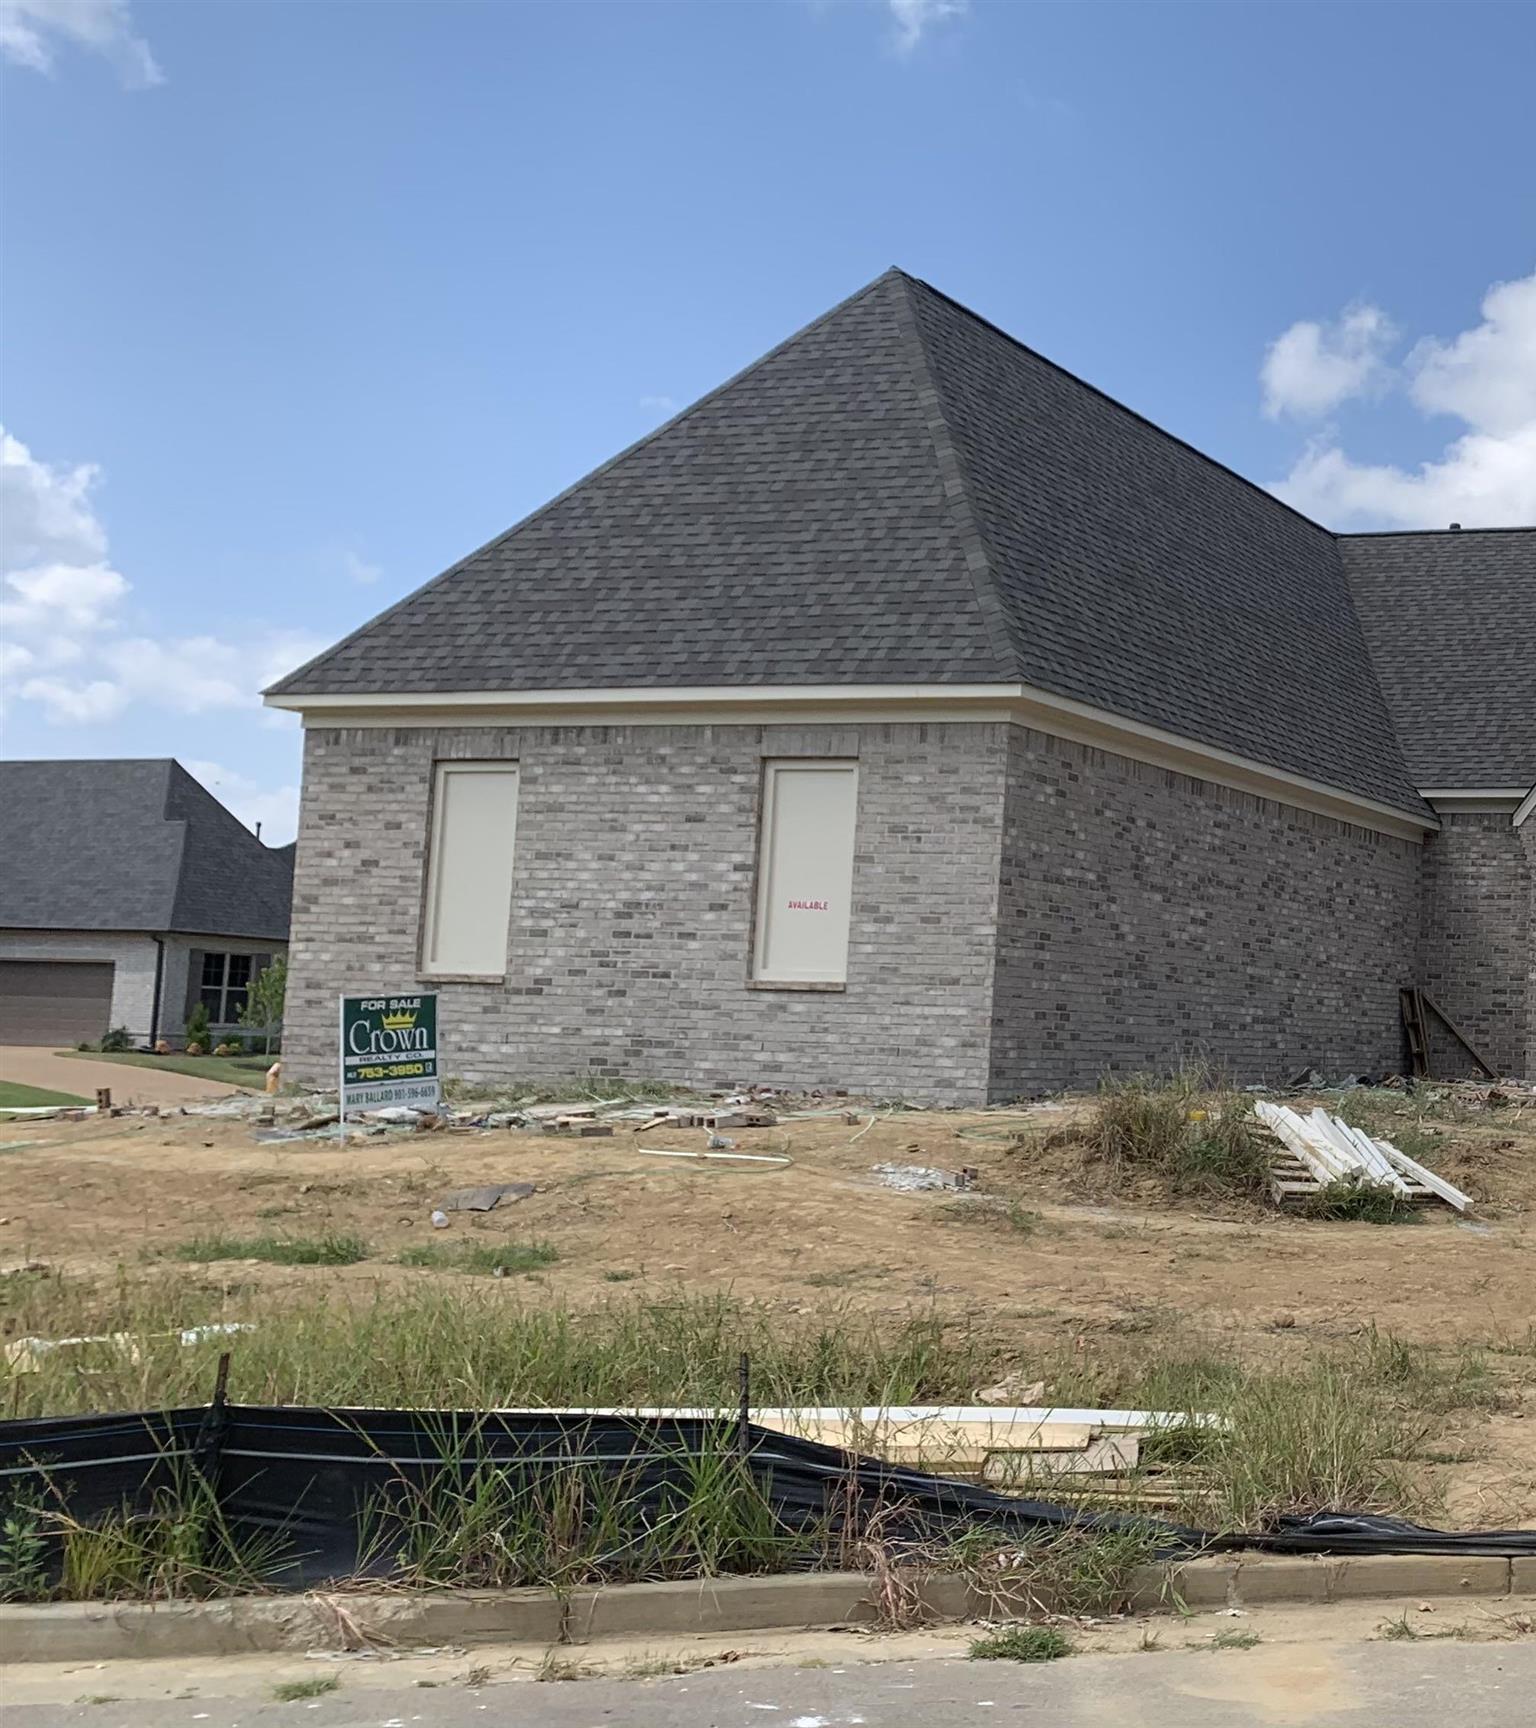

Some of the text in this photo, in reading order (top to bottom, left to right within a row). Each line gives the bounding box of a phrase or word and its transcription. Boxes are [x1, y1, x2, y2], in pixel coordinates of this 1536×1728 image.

[788, 901, 828, 910] AVAILABLE
[361, 998, 421, 1011] FOR SALE
[349, 1020, 428, 1054] Crown
[359, 1055, 401, 1063] REALTY
[358, 1064, 423, 1079] 753-3950
[347, 1093, 364, 1105] MARY
[366, 1089, 393, 1104] BALLARD
